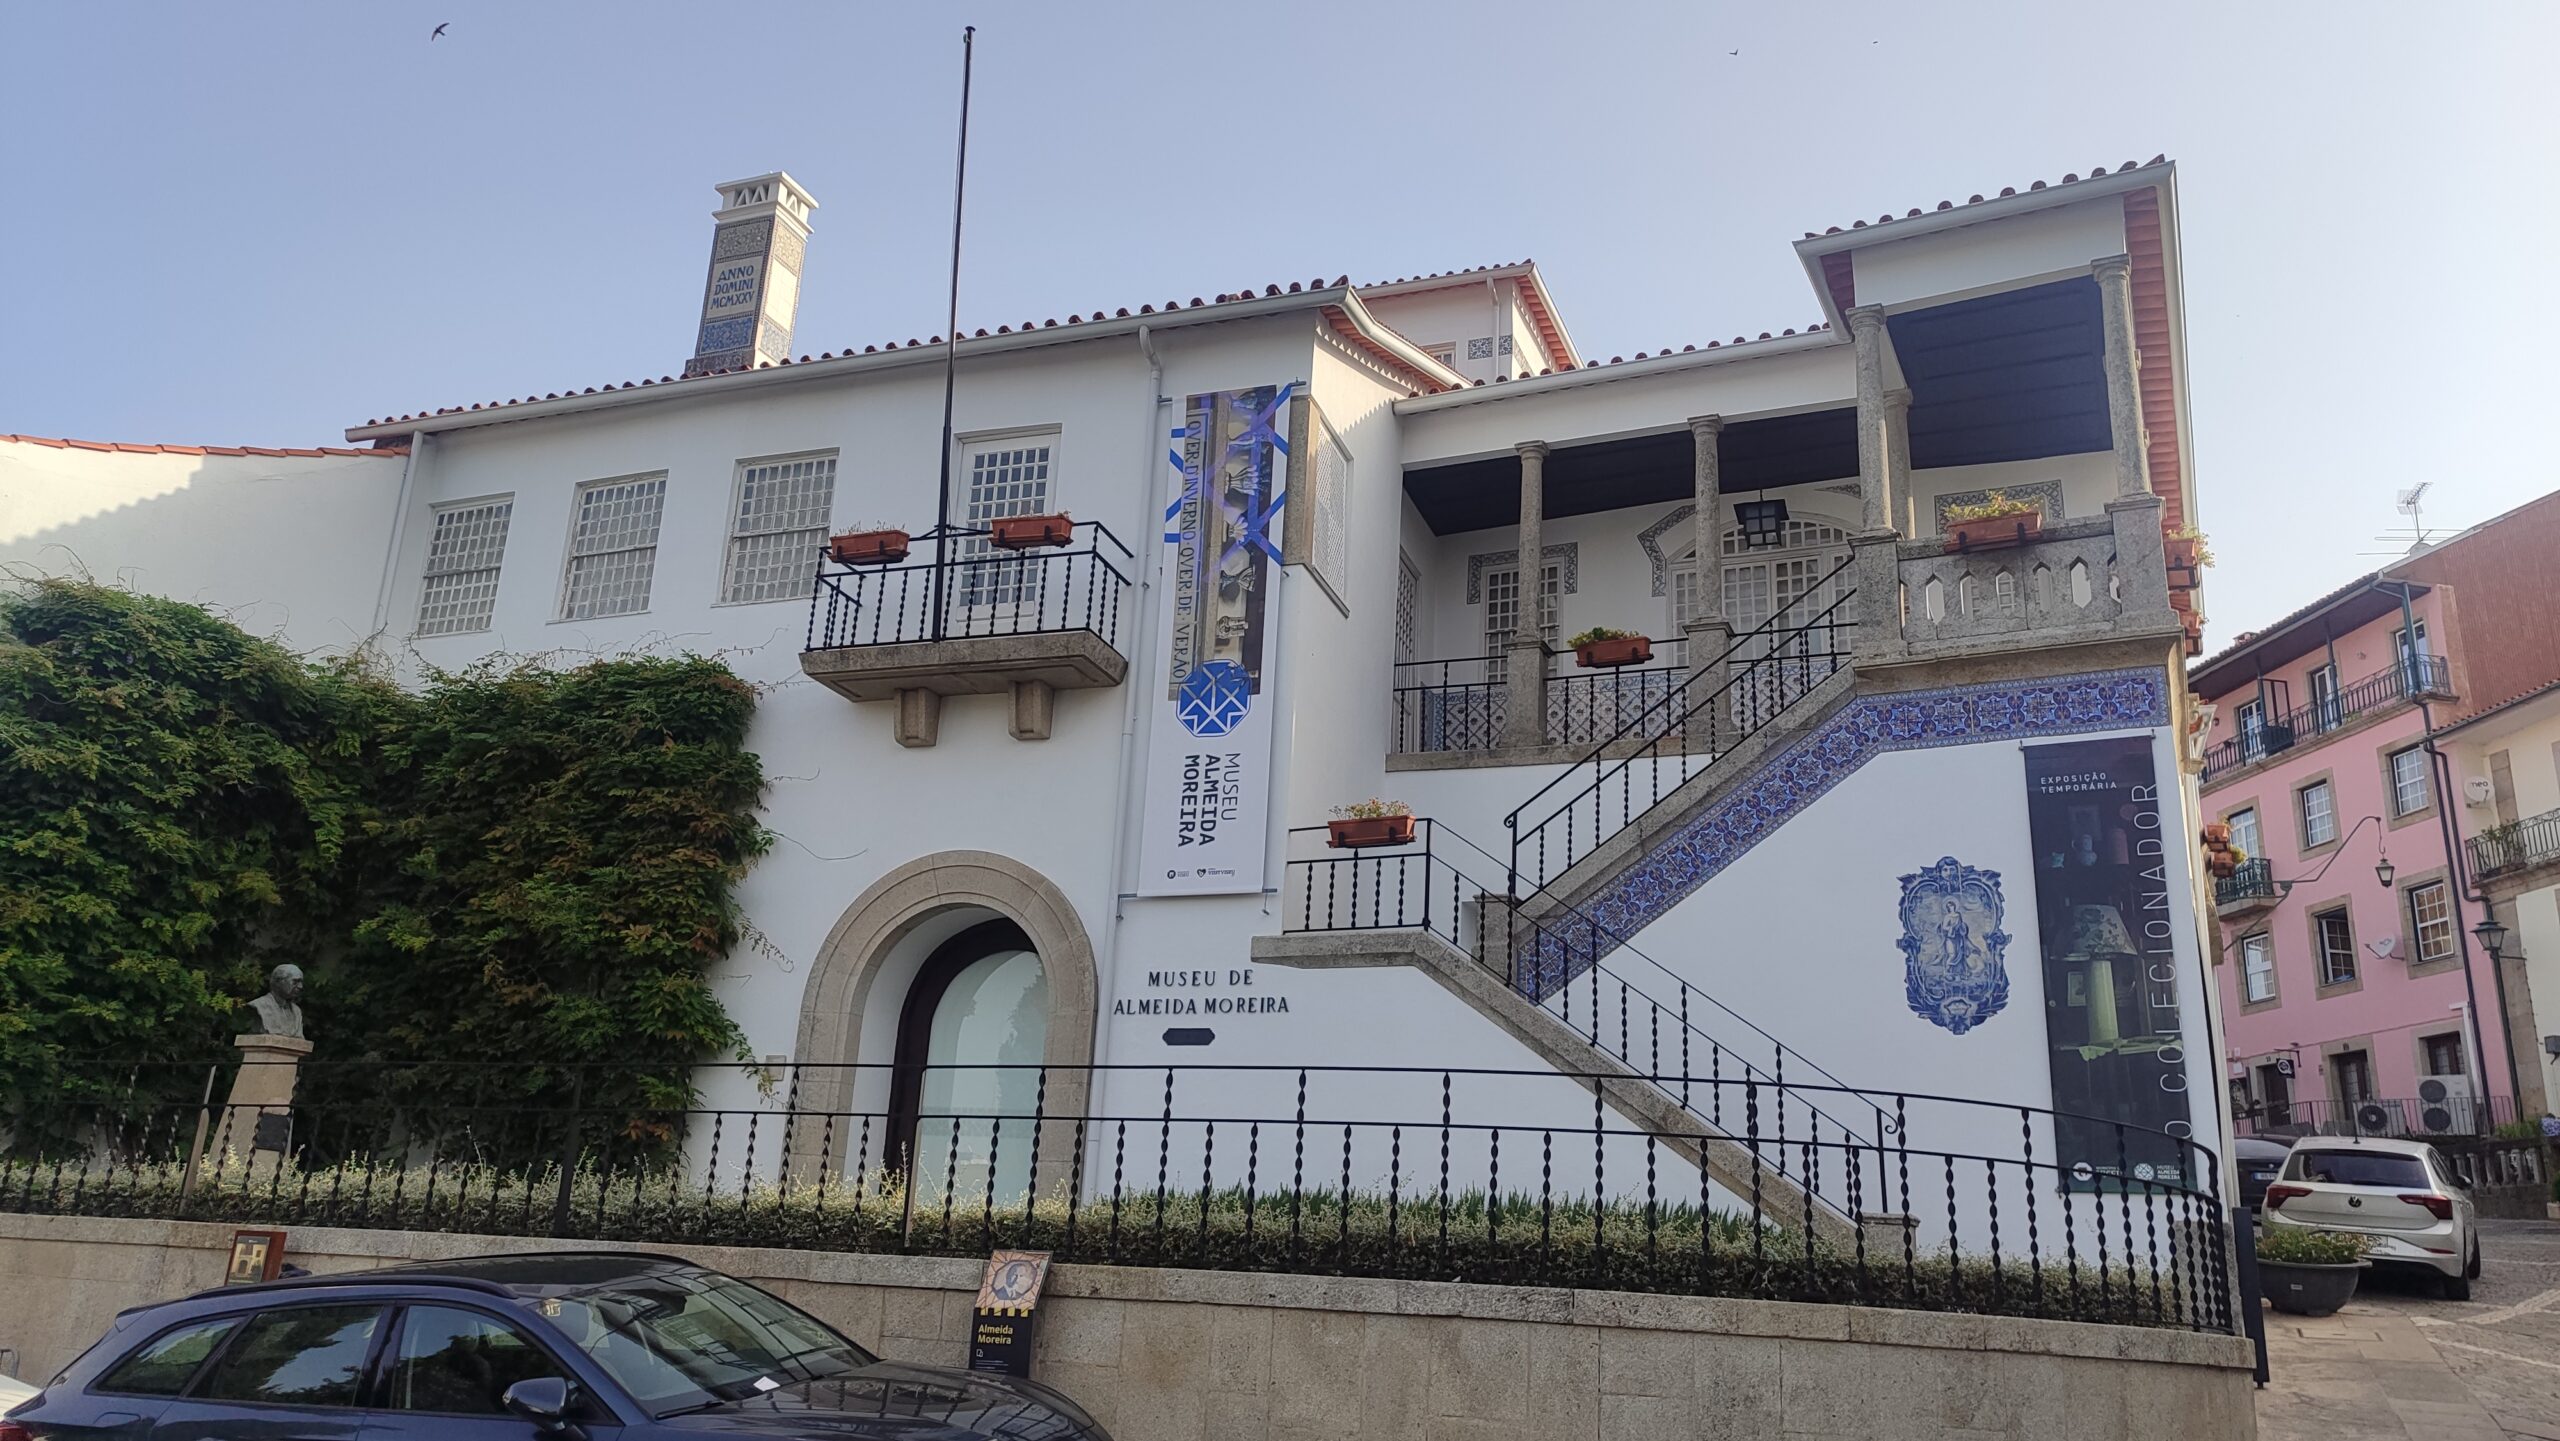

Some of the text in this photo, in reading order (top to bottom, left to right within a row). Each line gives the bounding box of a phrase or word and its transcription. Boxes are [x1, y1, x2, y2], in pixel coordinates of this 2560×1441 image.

[717, 265, 754, 283] ANNO
[714, 278, 754, 296] DOMINI
[710, 291, 755, 310] MCMXXV
[1220, 753, 1241, 821] MUSEU
[2040, 772, 2107, 785] EXPOSIÇÃO
[2041, 781, 2118, 794] TEMPORÁRIA
[1177, 755, 1200, 848] MOREIRA
[1198, 754, 1221, 846] ALMEIDA
[2131, 784, 2188, 1092] COLECIONADOR
[1148, 969, 1254, 987] MUSEU DE
[1114, 997, 1290, 1015] ALMEIDA MOREIRA
[978, 1324, 1014, 1335] Almeida
[977, 1334, 1012, 1345] Moreira
